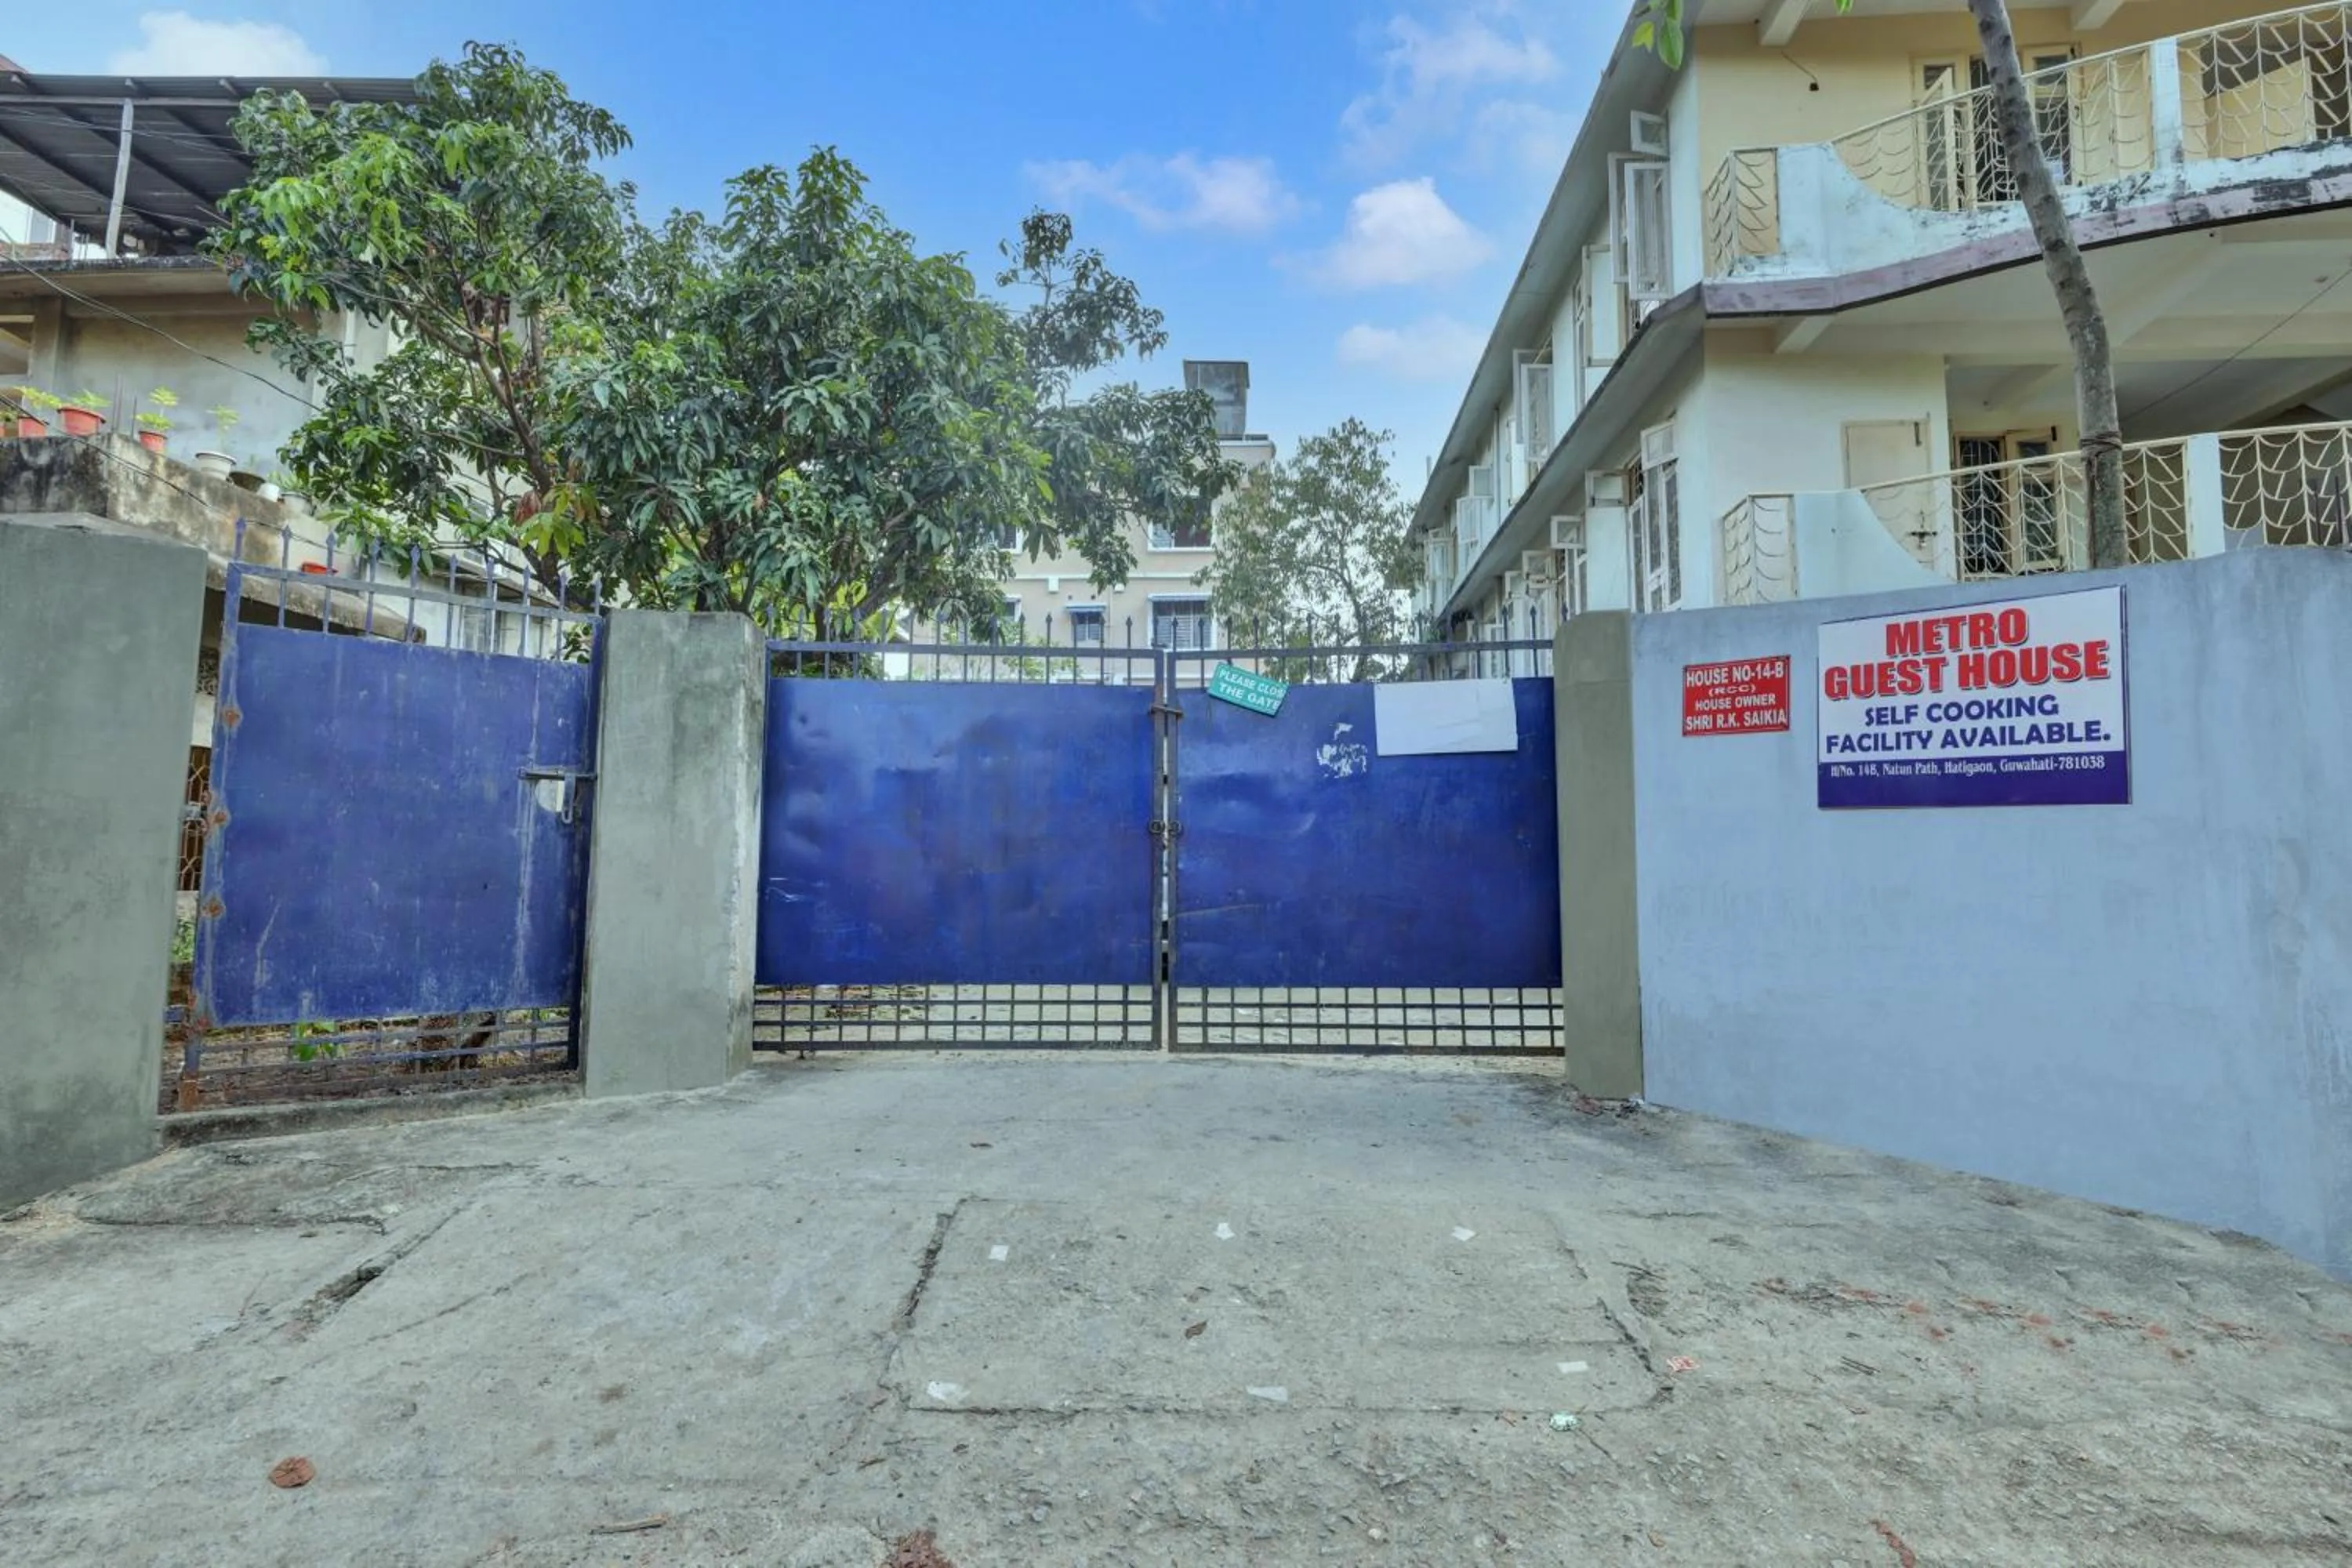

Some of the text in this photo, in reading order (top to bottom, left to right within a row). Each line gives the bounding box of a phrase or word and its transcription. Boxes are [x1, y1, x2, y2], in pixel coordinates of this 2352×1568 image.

[1886, 608, 2028, 657] METRO
[1219, 669, 1256, 689] PLEASE
[1686, 668, 1729, 688] HOUSE
[1824, 640, 2110, 700] GUEST HOUSE
[1219, 682, 1280, 710] THE GATE
[1695, 693, 1776, 711] HOUSE OWNER
[1686, 709, 1787, 731] SHRI R.K. SAIKIA
[1865, 695, 2059, 727] SELF COOKING
[1826, 720, 2111, 753] FACILITY AVAILABLE.
[1883, 763, 1912, 775] Natun
[1915, 761, 1941, 775] Path,
[1945, 760, 1997, 776] Hatigaon,
